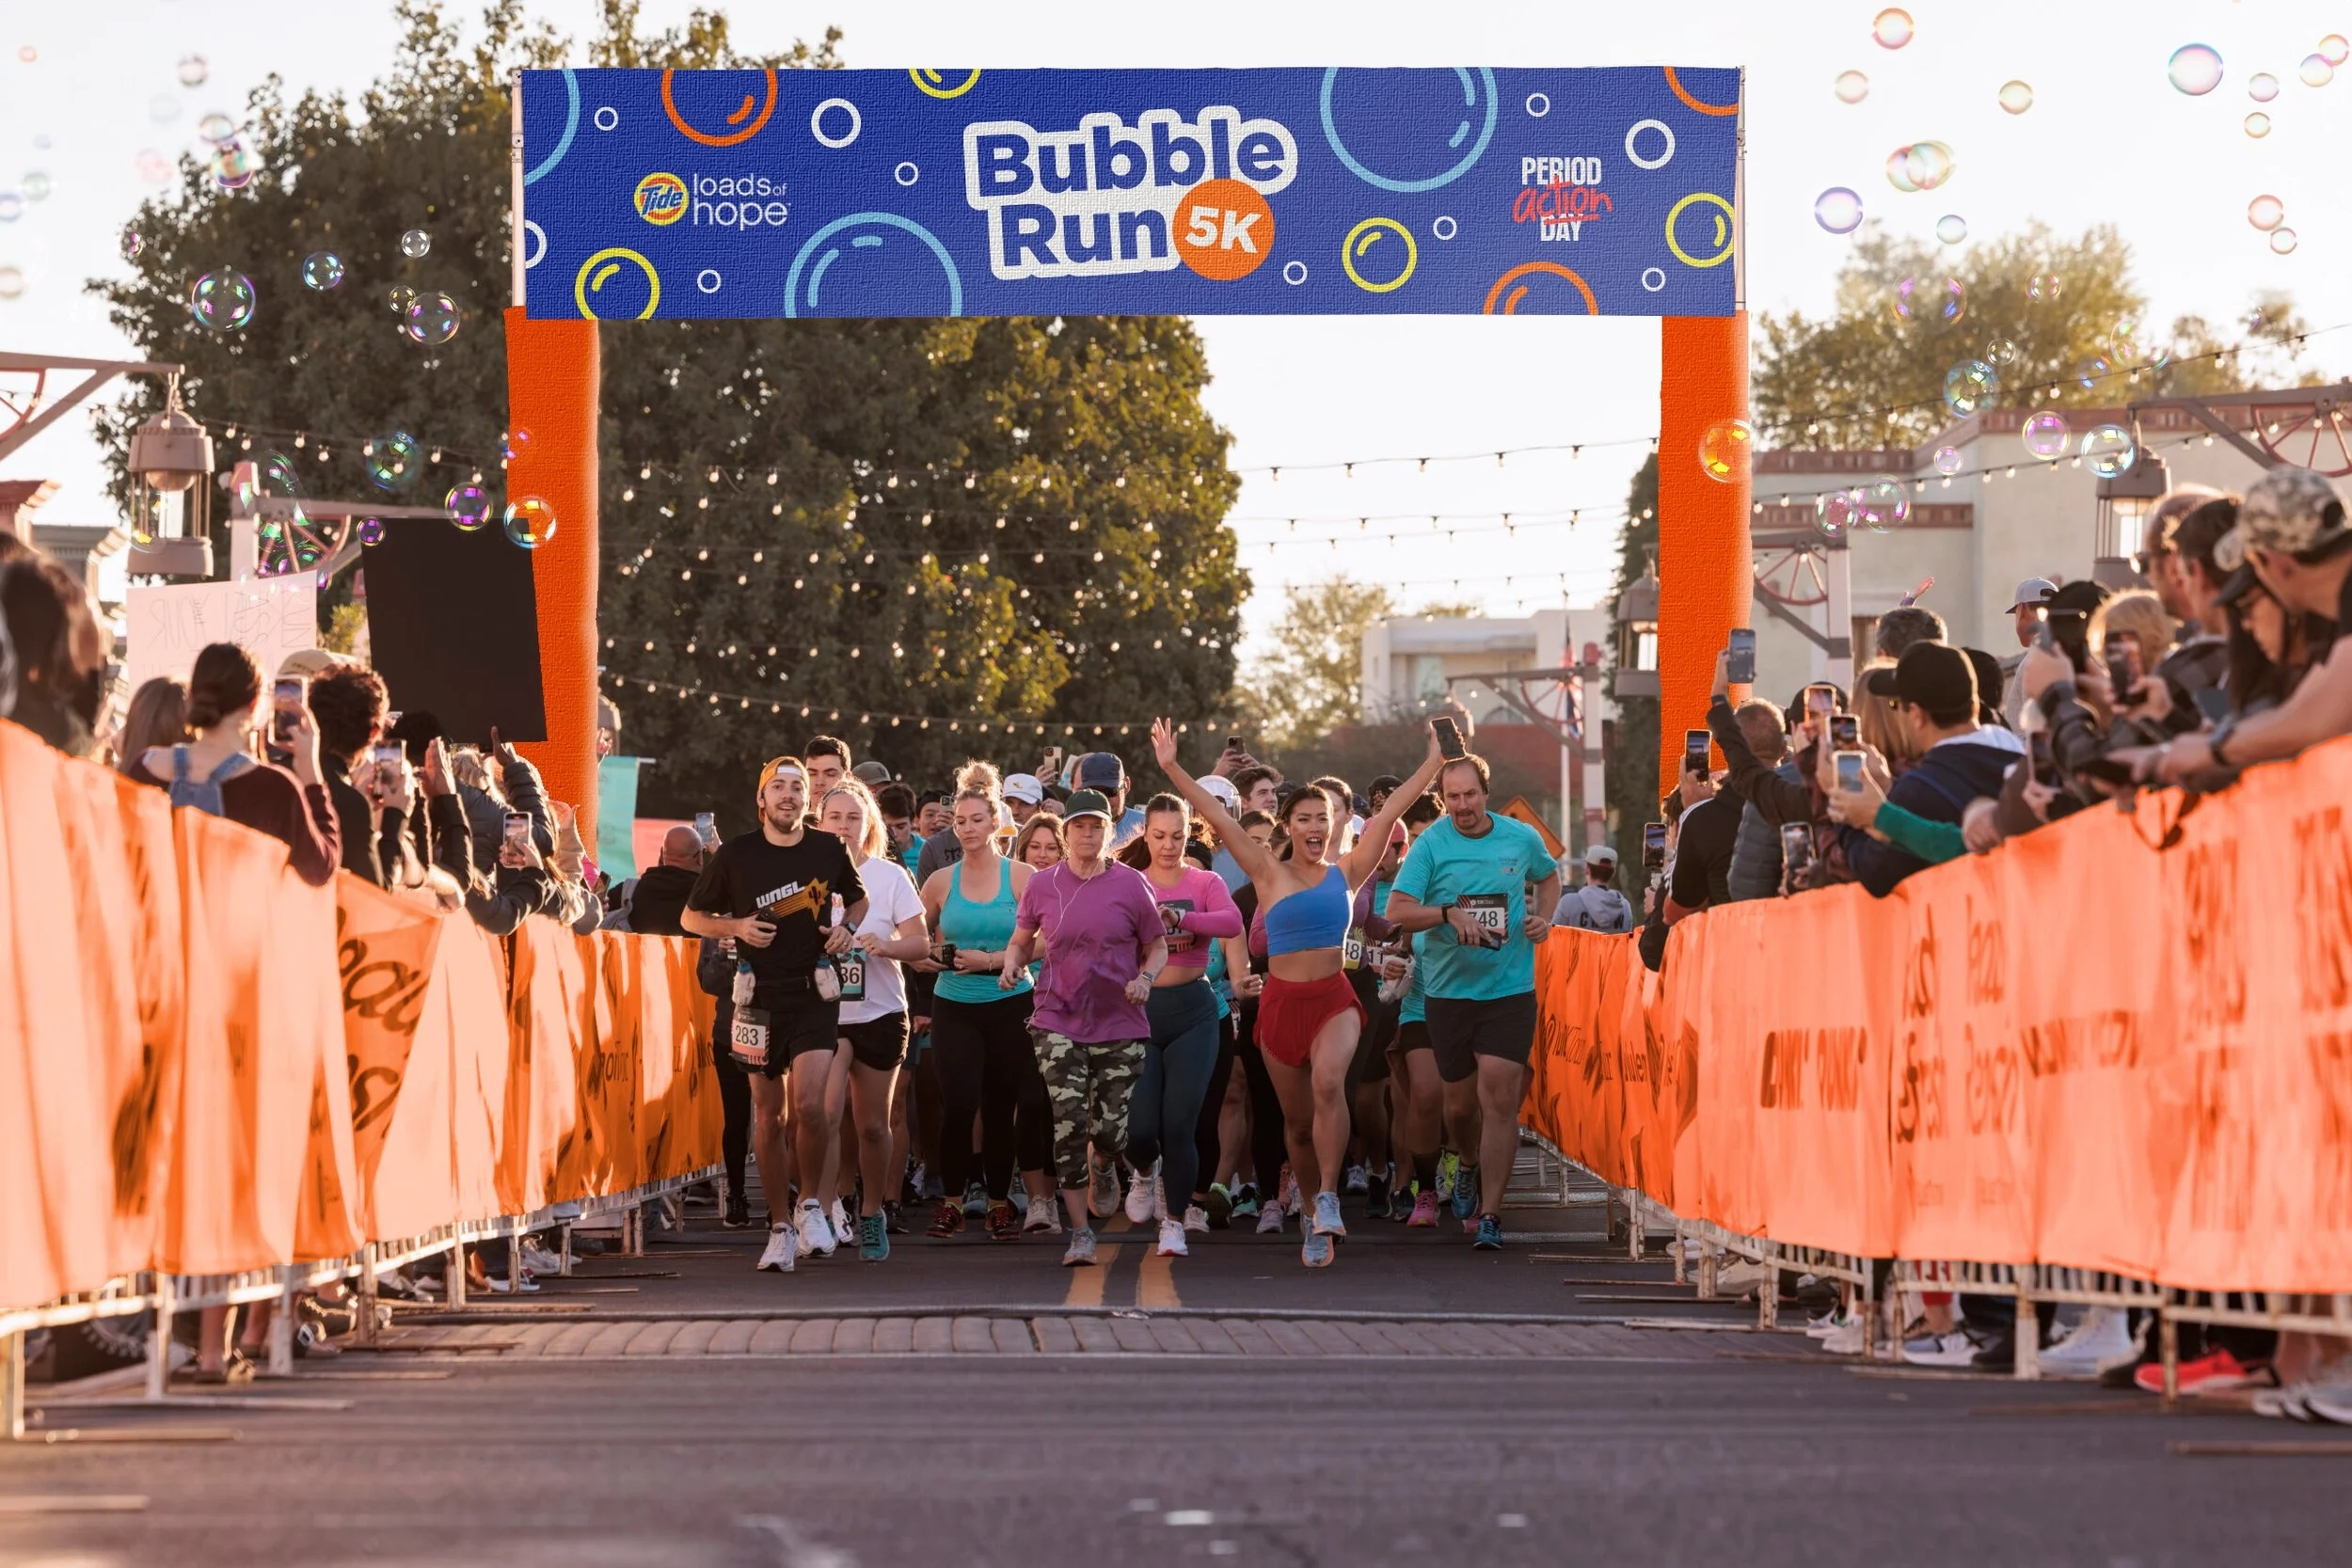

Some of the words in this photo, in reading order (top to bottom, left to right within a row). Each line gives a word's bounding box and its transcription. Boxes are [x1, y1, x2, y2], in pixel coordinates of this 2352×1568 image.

[975, 119, 1287, 198] Bubble
[1521, 156, 1602, 185] PERIOD
[639, 183, 685, 217] Tide
[693, 173, 771, 196] loads
[772, 182, 787, 196] of
[1512, 173, 1613, 224] action
[693, 197, 788, 231] hope
[1184, 205, 1263, 254] 5K
[1540, 213, 1584, 242] DAY
[1000, 200, 1169, 268] Run
[1580, 911, 1625, 929] CW
[735, 1024, 759, 1046] 283
